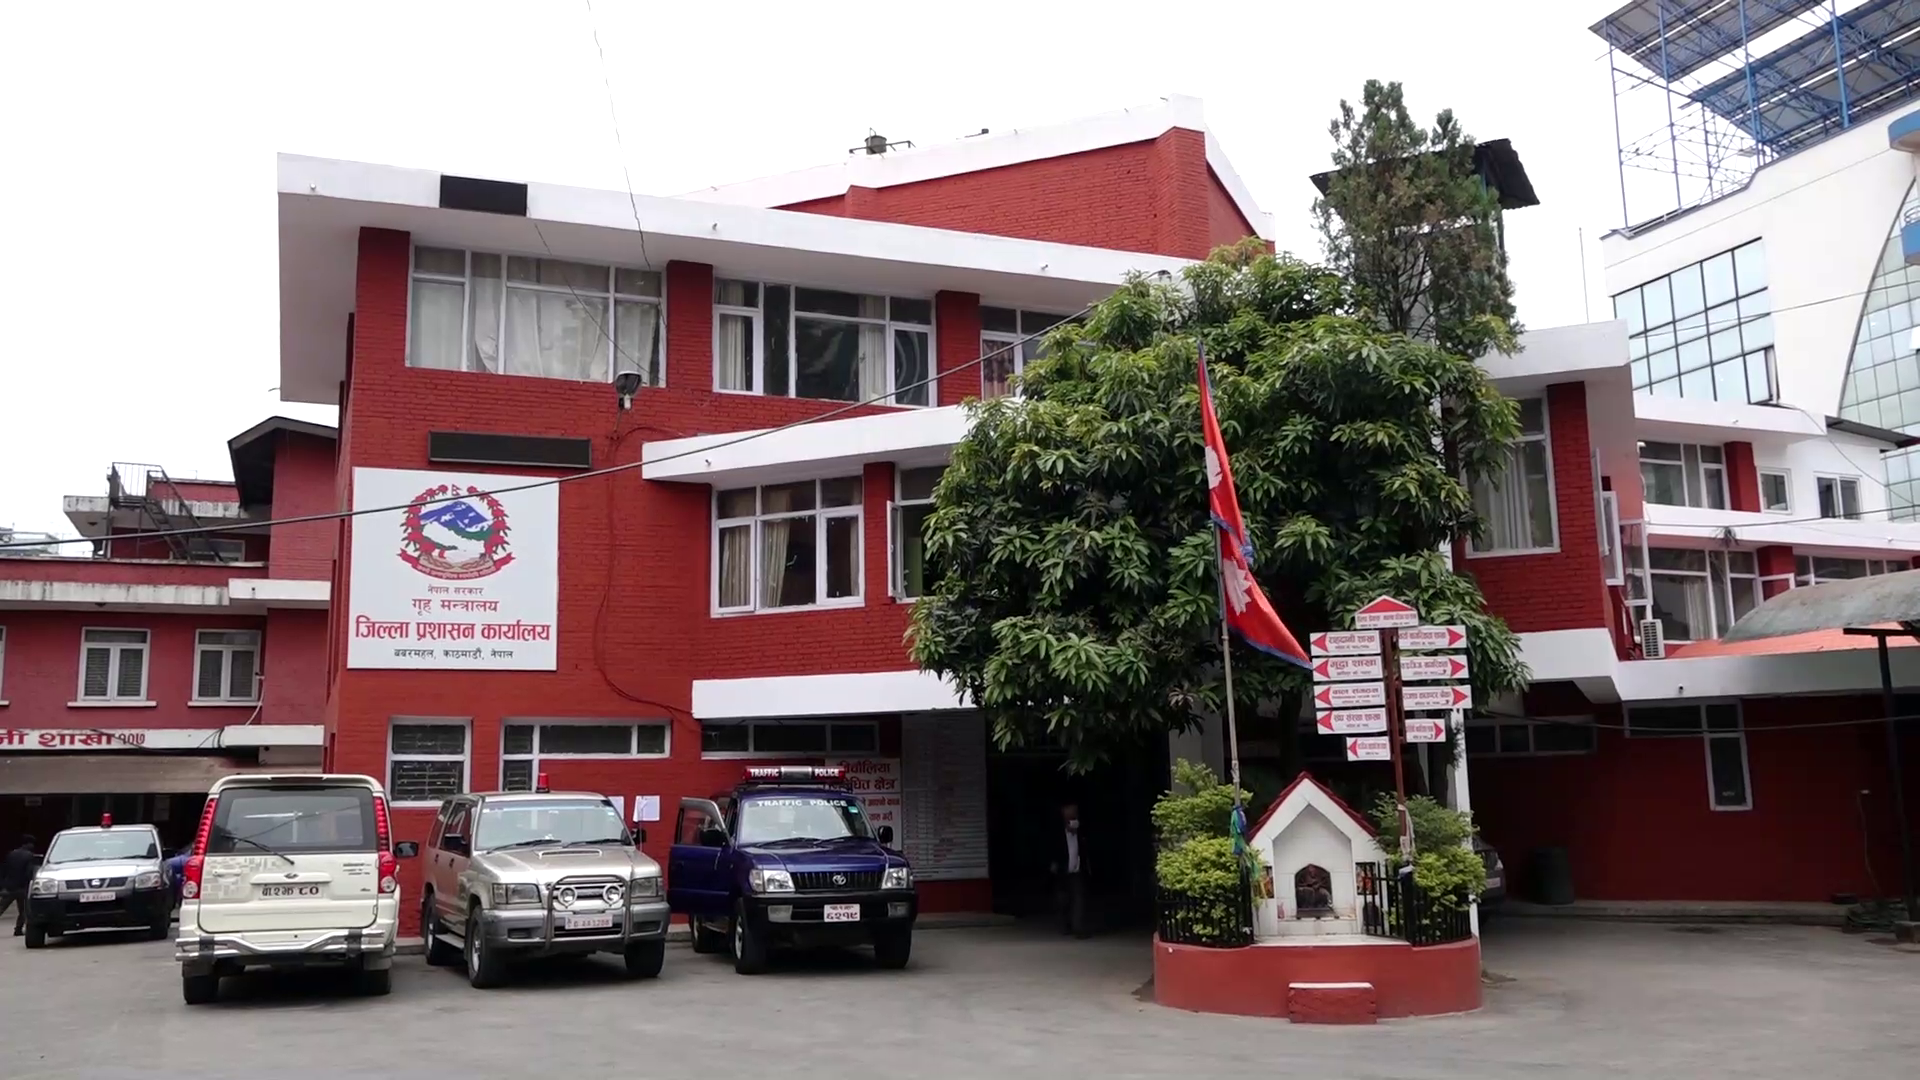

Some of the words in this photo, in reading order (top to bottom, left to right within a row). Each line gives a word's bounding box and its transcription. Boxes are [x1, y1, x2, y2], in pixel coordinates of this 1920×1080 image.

[428, 584, 449, 595] नेपाल
[454, 587, 484, 596] सरकार
[412, 598, 432, 616] गृह
[441, 599, 500, 612] मन्त्रालय
[355, 614, 410, 639] जिल्ला
[416, 621, 475, 641] प्रशासन
[481, 619, 551, 641] कार्यालय
[491, 649, 513, 659] नेपाल
[1351, 659, 1377, 668] शाखा
[38, 733, 115, 747] शाखा
[750, 768, 780, 777] TRAFFIC
[814, 768, 840, 777] POLICE
